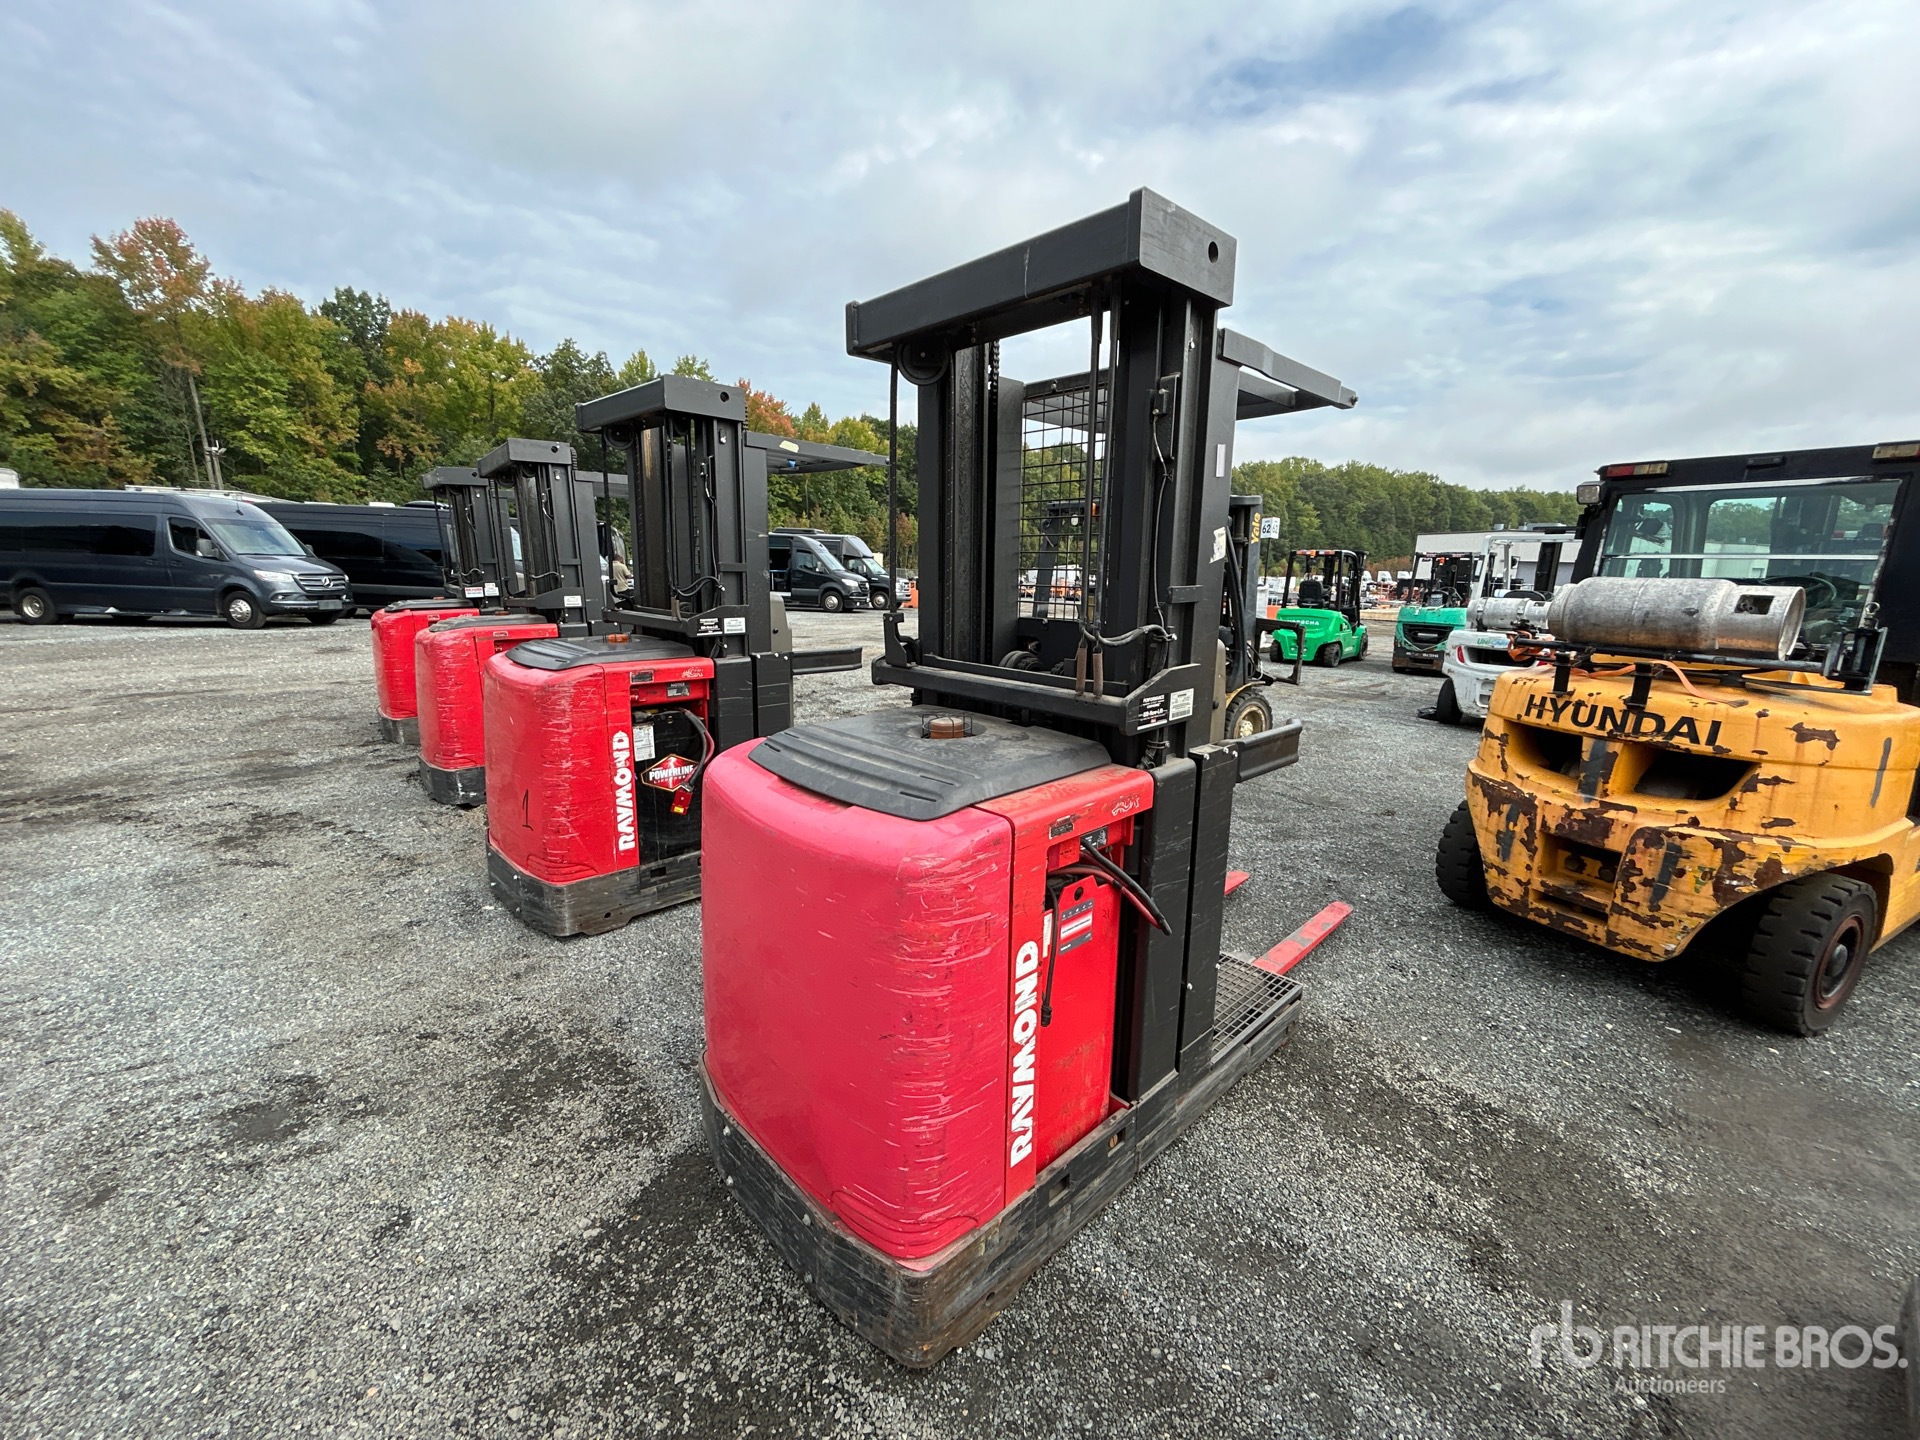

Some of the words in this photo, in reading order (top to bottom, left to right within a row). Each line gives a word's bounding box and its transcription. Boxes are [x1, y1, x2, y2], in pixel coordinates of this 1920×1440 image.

[1250, 512, 1261, 544] Yale
[1262, 524, 1271, 534] 62
[1524, 694, 1722, 747] HYUNDAI
[612, 730, 636, 851] RAYMOND
[1010, 940, 1039, 1168] RAYMOND
